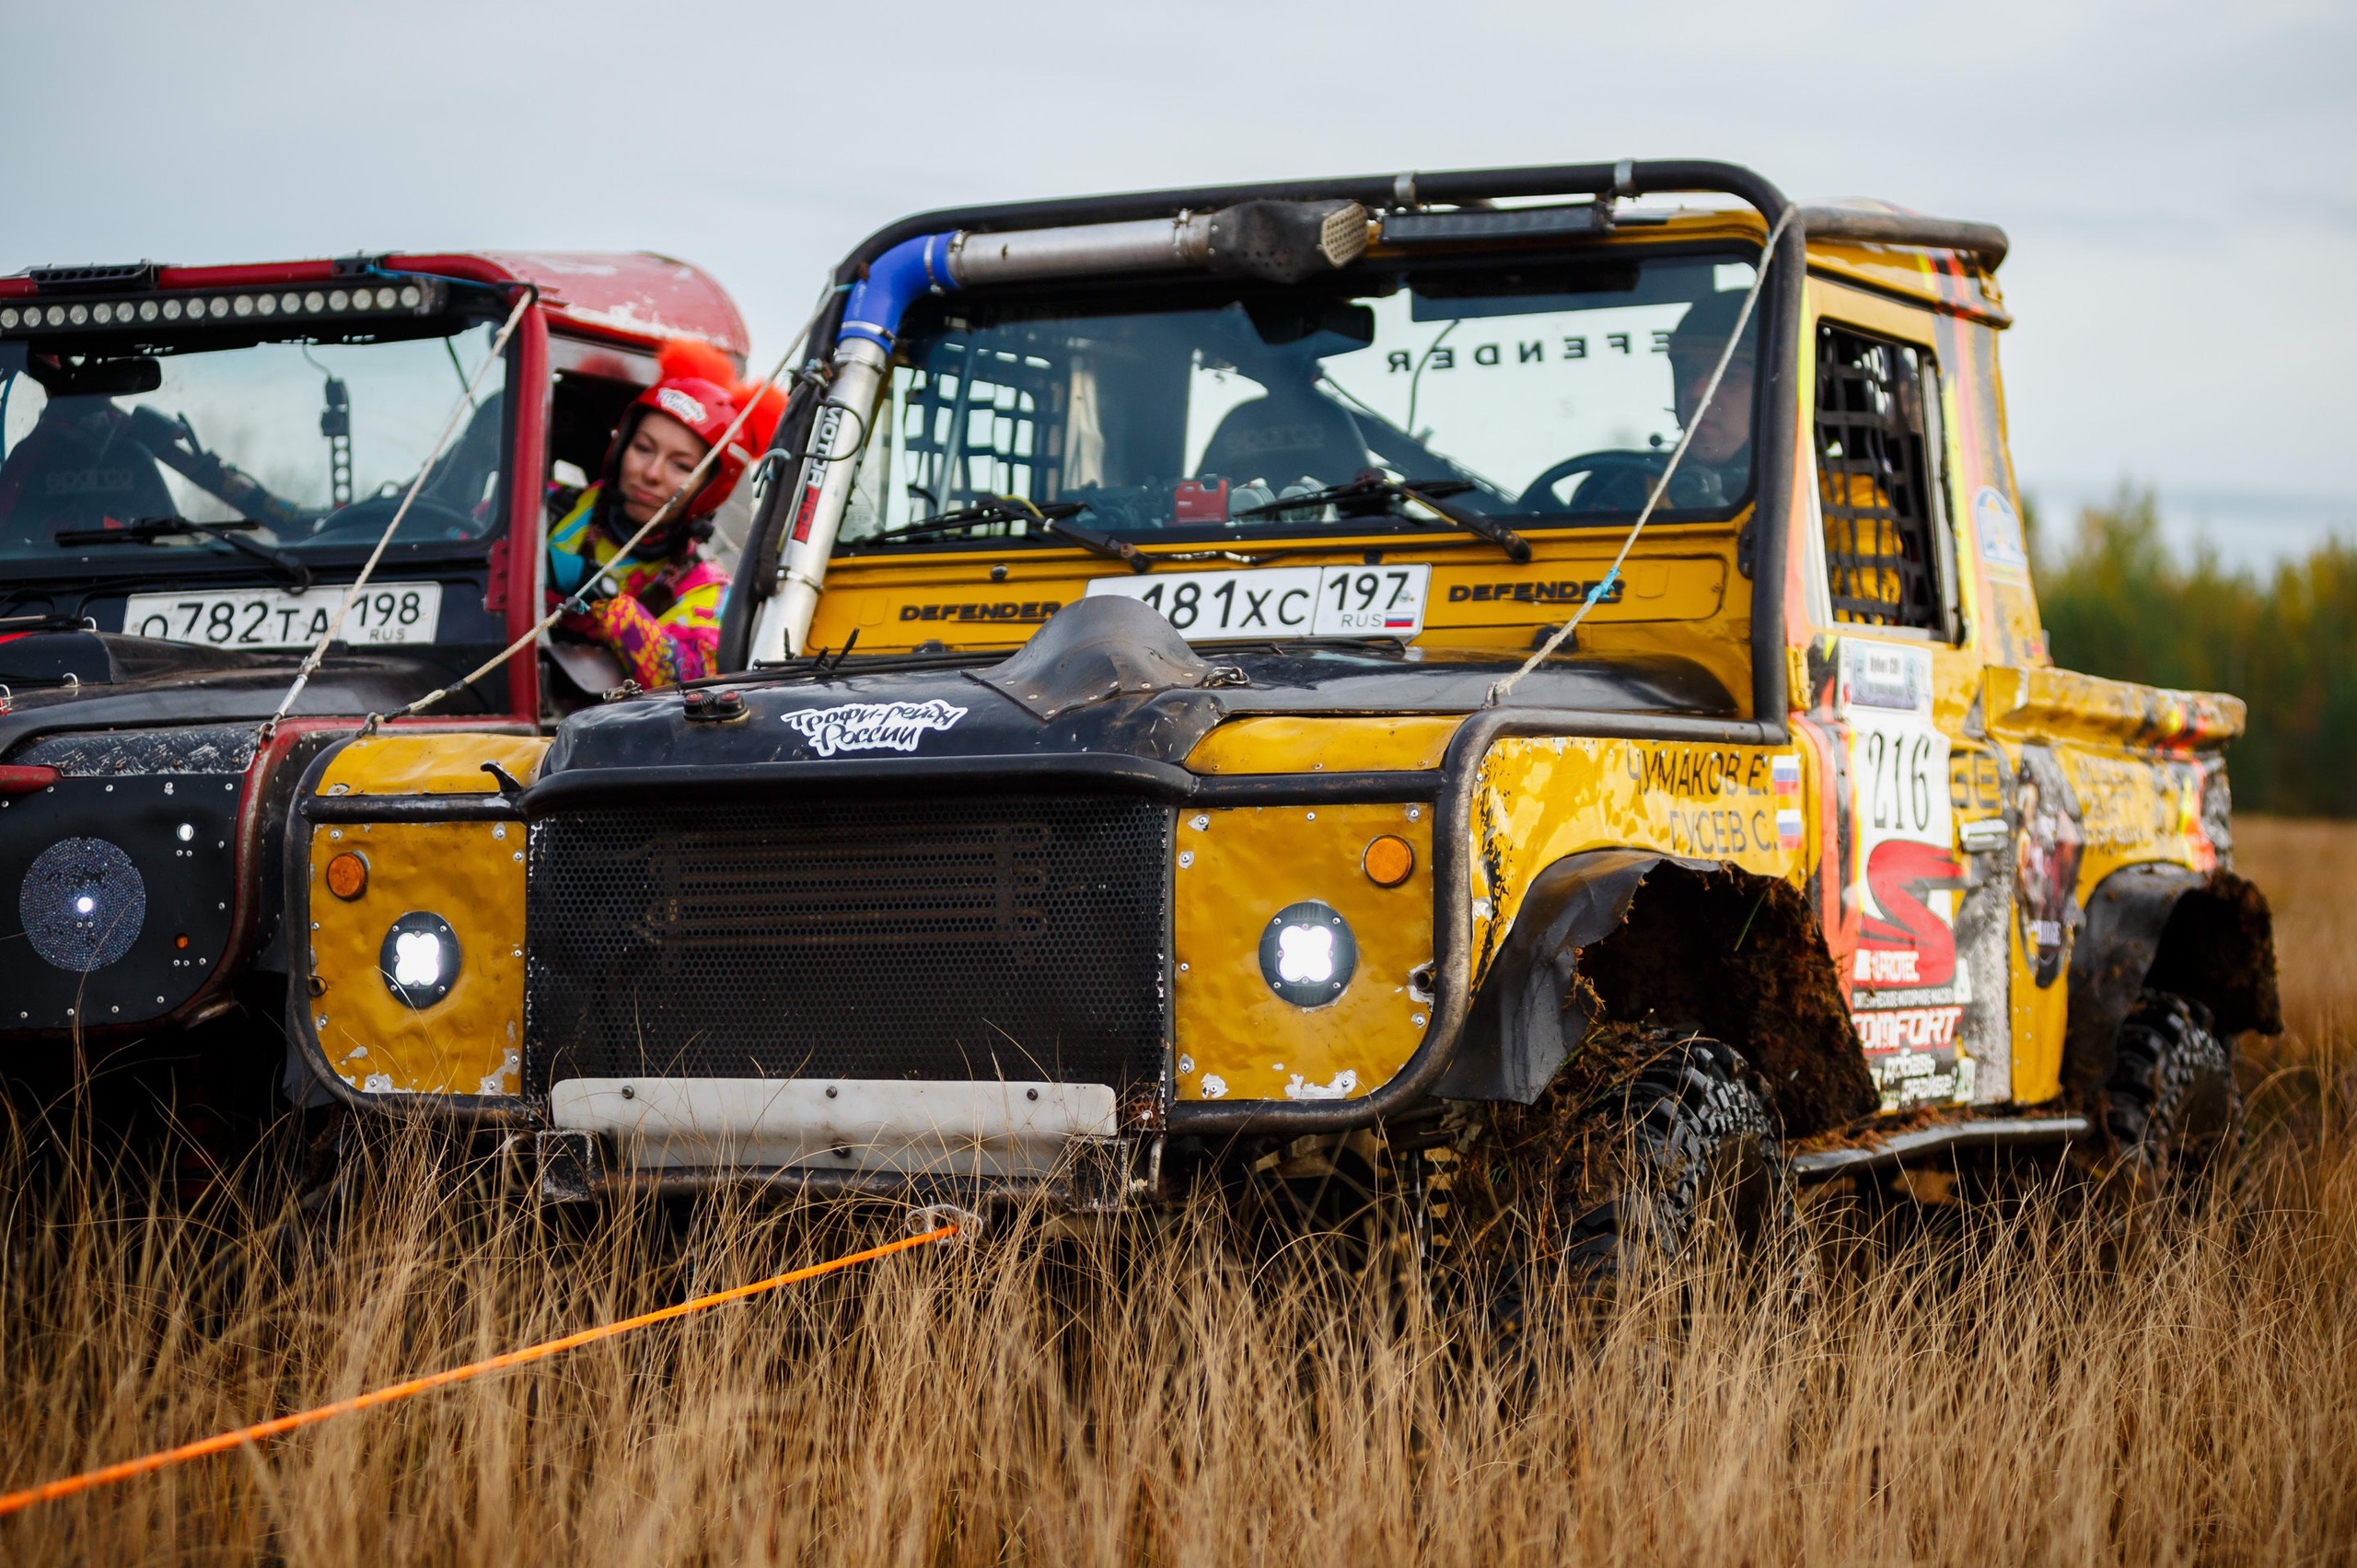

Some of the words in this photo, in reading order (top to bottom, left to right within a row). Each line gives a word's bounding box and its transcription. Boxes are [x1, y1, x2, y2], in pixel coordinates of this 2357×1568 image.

[1141, 579, 1309, 630] 181ХС
[1329, 572, 1411, 611] 197
[1448, 579, 1626, 602] DEFENDER
[352, 592, 421, 628] 198
[900, 601, 1062, 621] DEFENDER
[1341, 612, 1382, 627] RUS
[369, 628, 406, 641] RUS
[1626, 749, 1741, 796] ЧУМАКОВ
[1747, 754, 1769, 796] Е.
[1867, 731, 1931, 831] 216
[1669, 809, 1747, 855] ГУСЕВ
[1752, 809, 1779, 852] С.
